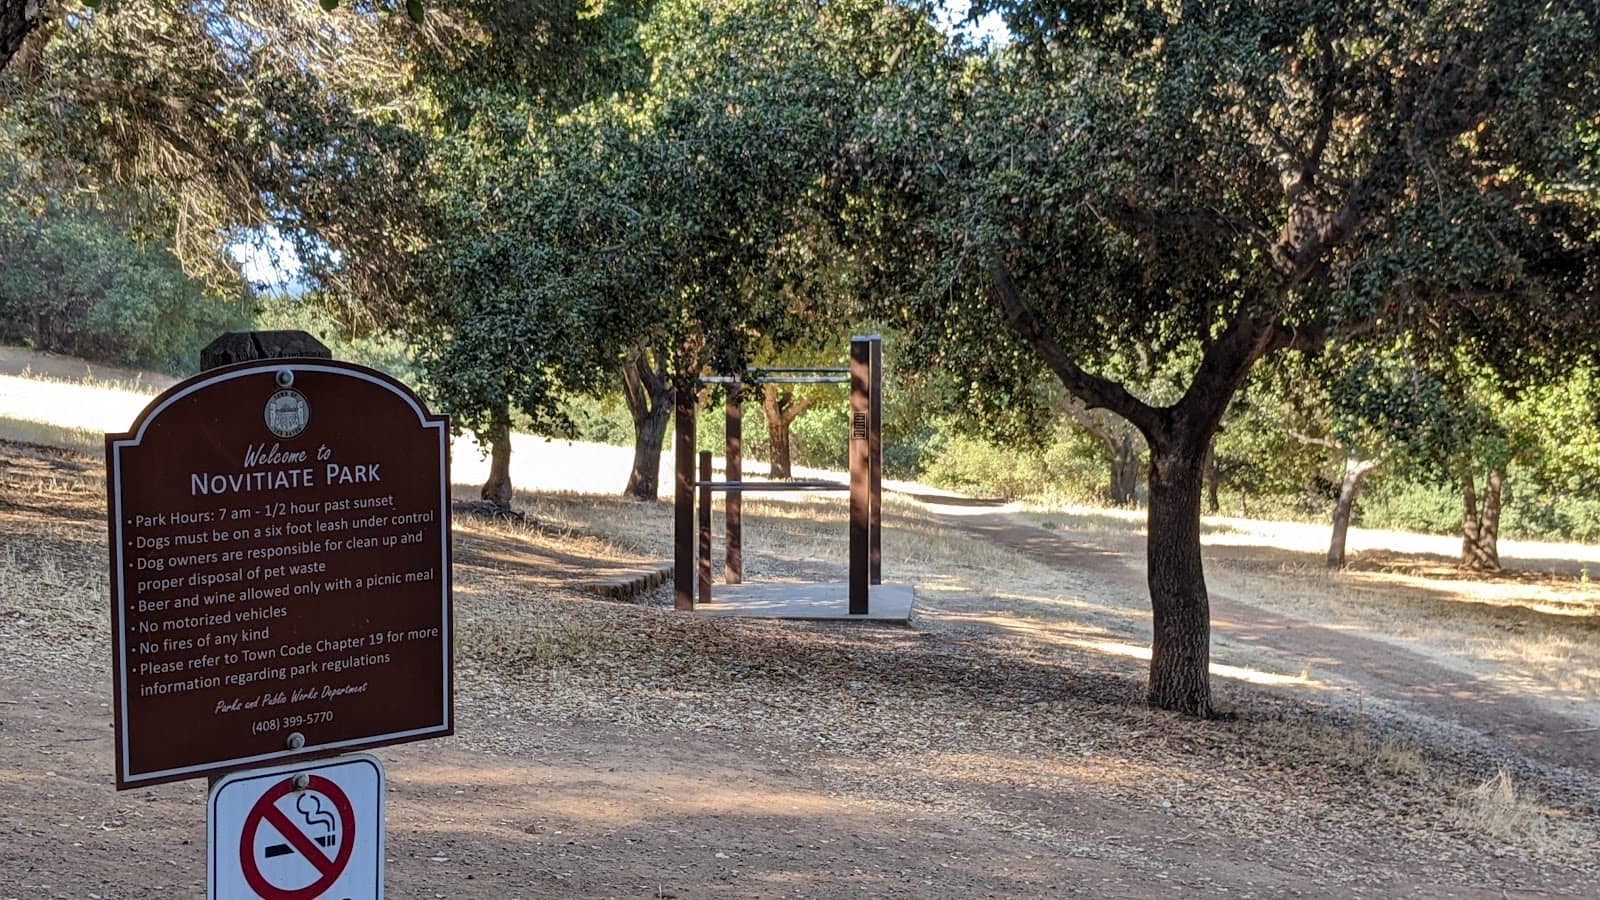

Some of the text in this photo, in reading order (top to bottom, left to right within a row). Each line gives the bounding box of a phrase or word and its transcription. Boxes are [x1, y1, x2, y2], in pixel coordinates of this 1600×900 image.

[244, 442, 331, 468] Welcome to
[191, 463, 380, 496] NOVITIATE PARK
[136, 513, 166, 527] Park
[170, 512, 215, 525] Hours:
[219, 508, 227, 521] 7
[231, 509, 251, 520] am
[265, 502, 286, 518] 1/2
[290, 502, 320, 514] hour
[324, 499, 350, 514] past
[354, 495, 393, 509] sunset
[136, 510, 433, 550] Dogs must be on a six foot leash under control
[137, 530, 422, 571] Dog owners are responsible for clean up and
[138, 562, 326, 594] proper disposal of pet waste
[138, 568, 433, 612] Beer and wine allowed only with a picnic meal
[139, 605, 287, 633] No motorized vehicles
[140, 626, 269, 654] No fires of any kind
[140, 628, 438, 675] Please refer to Town Code Chapter 19 for more
[141, 653, 390, 697] information regarding park regulations
[214, 682, 368, 714] Parks and Public Works Department
[252, 710, 333, 735] (408) 399-5770
